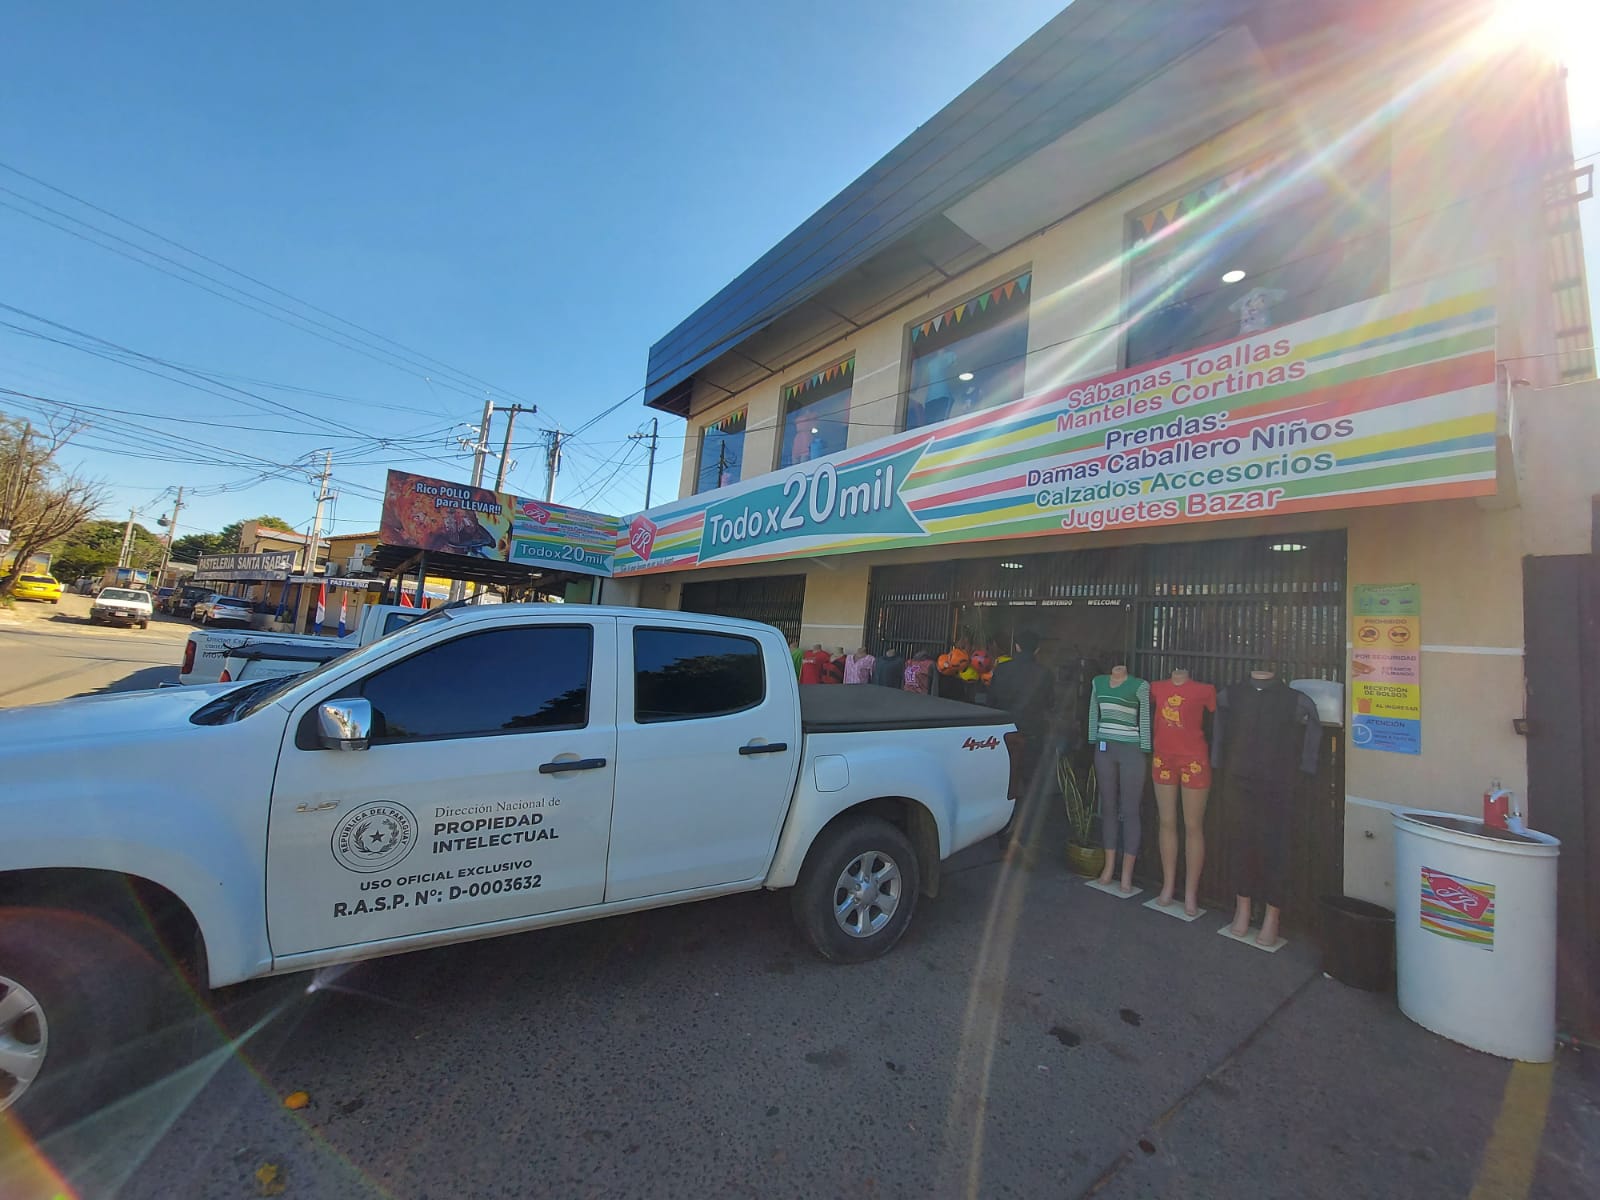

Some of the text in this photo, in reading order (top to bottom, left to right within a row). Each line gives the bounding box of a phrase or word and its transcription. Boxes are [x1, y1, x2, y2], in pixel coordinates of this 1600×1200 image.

[1067, 338, 1291, 410] Sábanas Toallas
[1057, 360, 1306, 433] Manteles Cortinas
[1106, 411, 1228, 450] Prendas:
[1027, 418, 1354, 487] Damas Caballero Niños
[416, 483, 470, 500] Rico POLLO
[839, 464, 893, 518] mil
[1036, 453, 1333, 508] Calzados Accesorios
[436, 498, 502, 514] para LLEVAR!!
[1062, 487, 1283, 529] Juguetes Bazar
[237, 556, 260, 570] SANTA
[961, 735, 1000, 751] 4x4
[434, 796, 561, 818] Dirección Nacional de
[434, 813, 543, 836] PROPIEDAD
[389, 809, 410, 845] PARAGUAY
[432, 828, 559, 854] INTELECTUAL
[360, 859, 533, 891] USO OFICIAL EXCLUSIVO
[333, 895, 409, 917] R.A.S.P.
[449, 874, 542, 900] D-0003632
